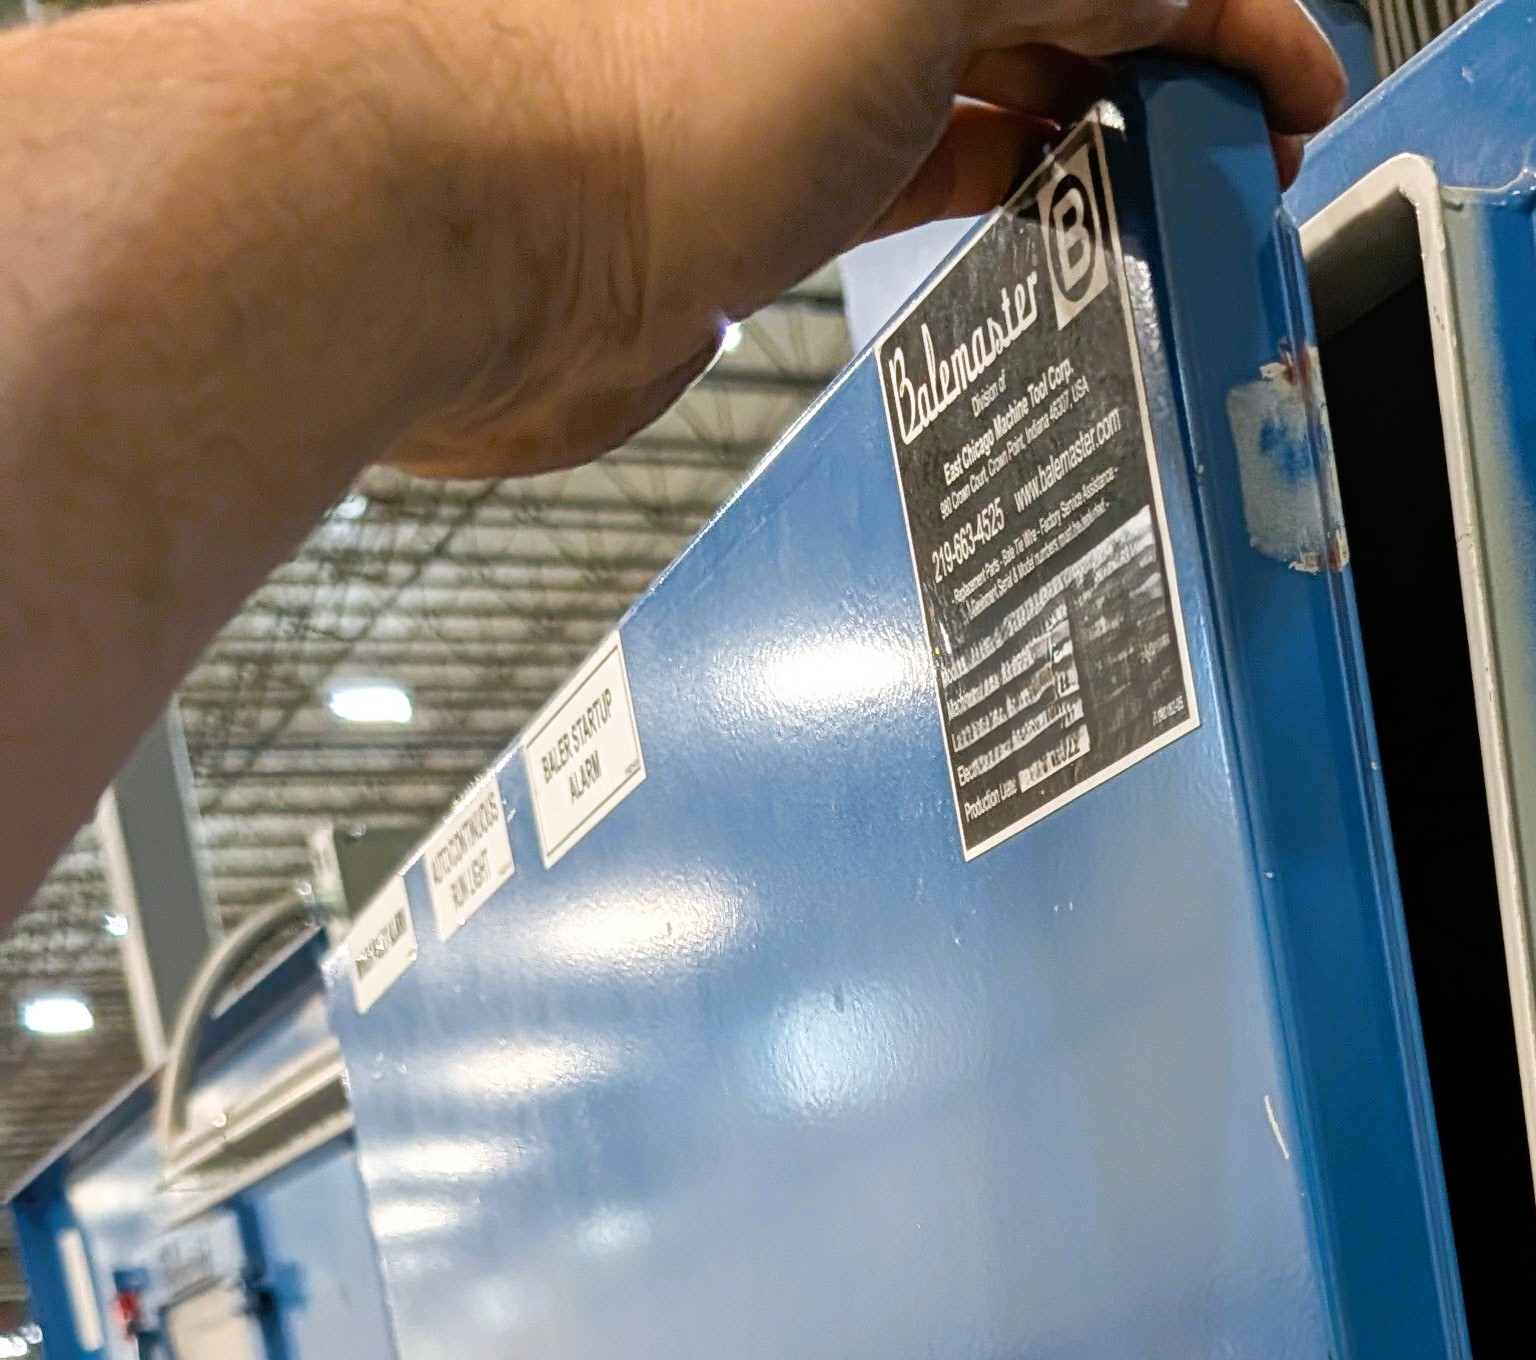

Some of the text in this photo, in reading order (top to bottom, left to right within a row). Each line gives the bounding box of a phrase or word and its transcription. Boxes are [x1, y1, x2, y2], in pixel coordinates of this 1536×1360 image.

[889, 269, 1037, 444] Balemaster
[971, 368, 1006, 417] Division of
[939, 496, 952, 519] 980
[951, 483, 970, 509] Crown
[987, 450, 1008, 476] Crown
[1024, 413, 1049, 443] Indiana
[1071, 375, 1089, 402] USA
[943, 358, 1073, 485] East Chicago Machine Tool Corp.
[932, 408, 1120, 582] 219-663-4525 www.balemaster.com
[541, 688, 611, 783] BALER STARTUP
[569, 750, 600, 800] ALARM
[963, 788, 1000, 821] Production
